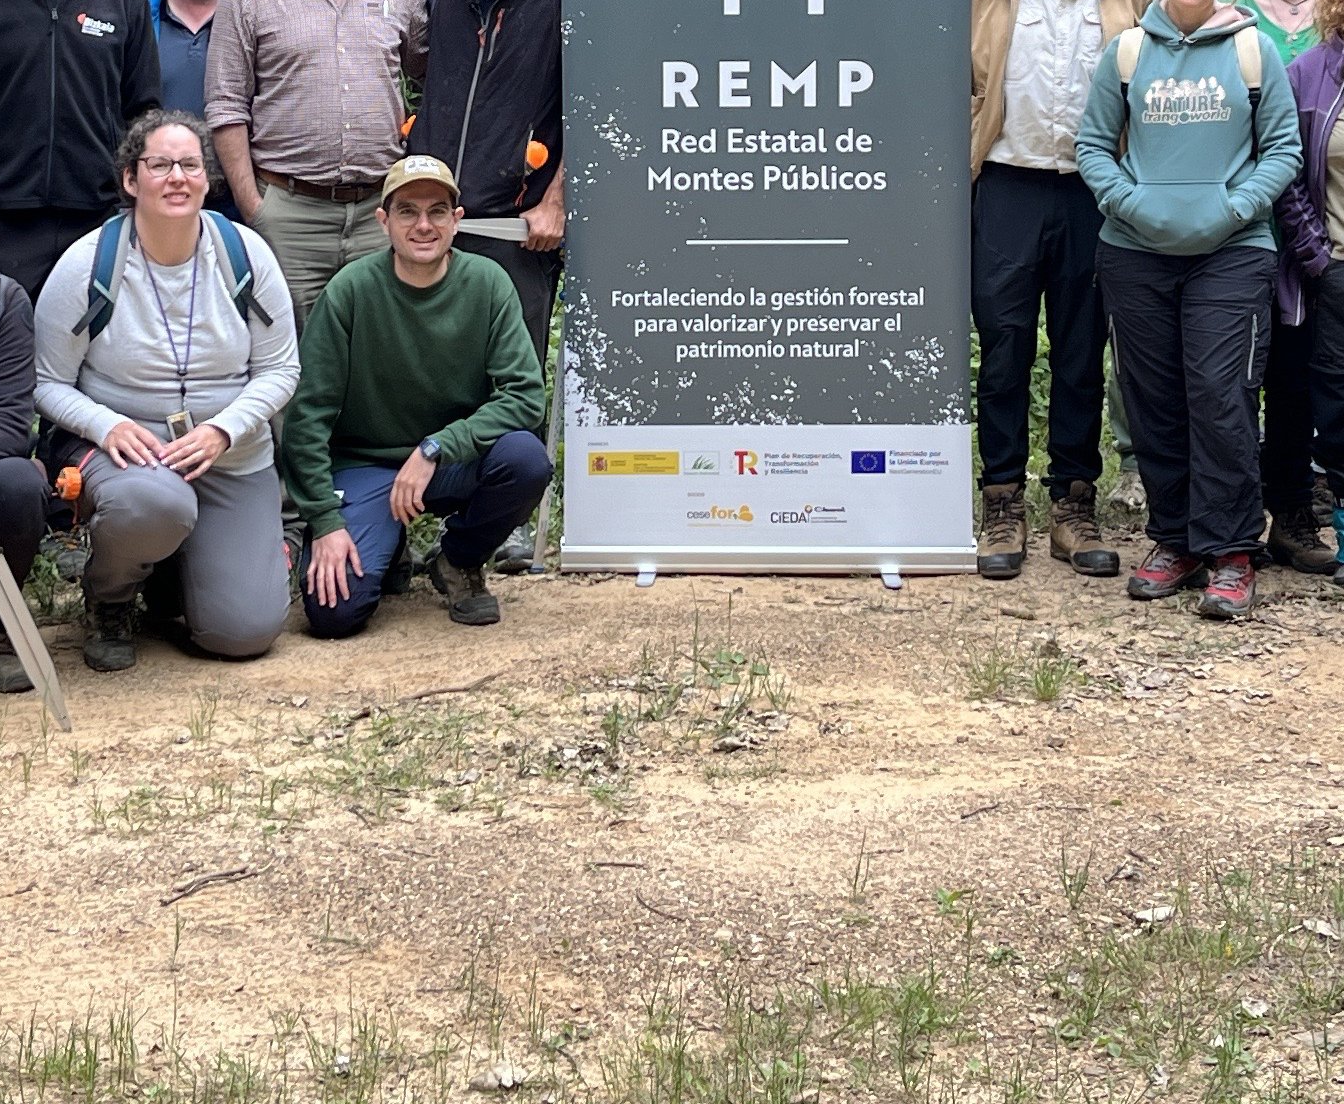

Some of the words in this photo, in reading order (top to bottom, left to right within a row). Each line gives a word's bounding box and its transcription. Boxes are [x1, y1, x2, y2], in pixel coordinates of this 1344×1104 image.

[662, 60, 874, 108] REMP
[1151, 94, 1220, 113] NATURE
[661, 128, 717, 154] Red
[727, 127, 828, 154] Estatal
[835, 127, 873, 153] de
[647, 166, 754, 192] Montes
[763, 164, 887, 191] Públicos
[611, 287, 746, 307] Fortaleciendo
[749, 287, 767, 307] la
[770, 287, 844, 311] gestión
[847, 286, 925, 307] forestal
[634, 318, 678, 337] para
[681, 314, 767, 333] valorizar
[771, 318, 783, 336] y
[786, 317, 881, 336] preservar
[883, 313, 902, 332] el
[676, 340, 786, 363] patrimonio
[789, 339, 861, 359] natural
